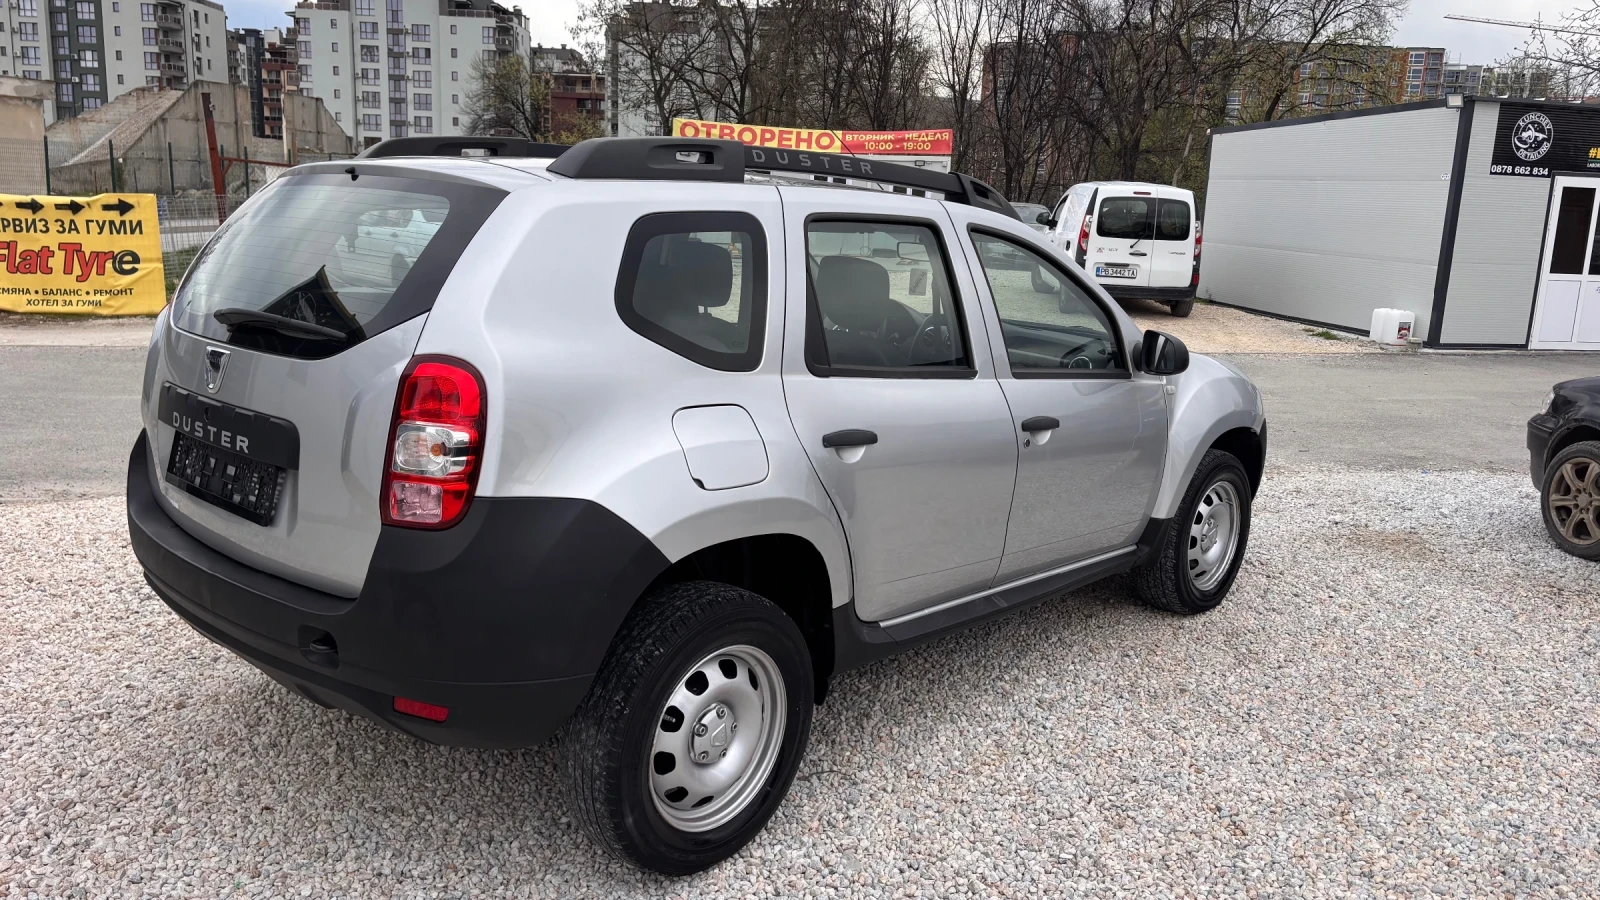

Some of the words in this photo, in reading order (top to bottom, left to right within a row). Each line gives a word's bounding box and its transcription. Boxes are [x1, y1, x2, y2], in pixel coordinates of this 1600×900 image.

[1519, 113, 1552, 129] KUNCHEV
[679, 121, 836, 150] ОТВОРЕНО
[845, 133, 895, 141] ВТОРНИК
[905, 132, 949, 142] НЕДЕЛЯ
[864, 142, 893, 151] 10:00
[903, 142, 931, 151] 19:00
[752, 149, 873, 175] DUSTER
[1491, 165, 1513, 174] 0878
[1514, 166, 1531, 175] 662
[1532, 167, 1549, 176] 834
[0, 217, 50, 234] РВИЗ
[54, 218, 80, 234] ЗА
[85, 219, 144, 235] ГУМИ
[58, 242, 141, 283] Tyre
[1110, 269, 1126, 277] 3442
[0, 287, 31, 296] МЯНА
[42, 288, 82, 296] БАЛАНС
[93, 287, 134, 297] РЕМОНТ
[26, 298, 59, 307] ХОТЕЛ
[61, 299, 75, 307] ЗА
[76, 299, 102, 307] ГУМИ
[172, 411, 249, 454] DUSTER
